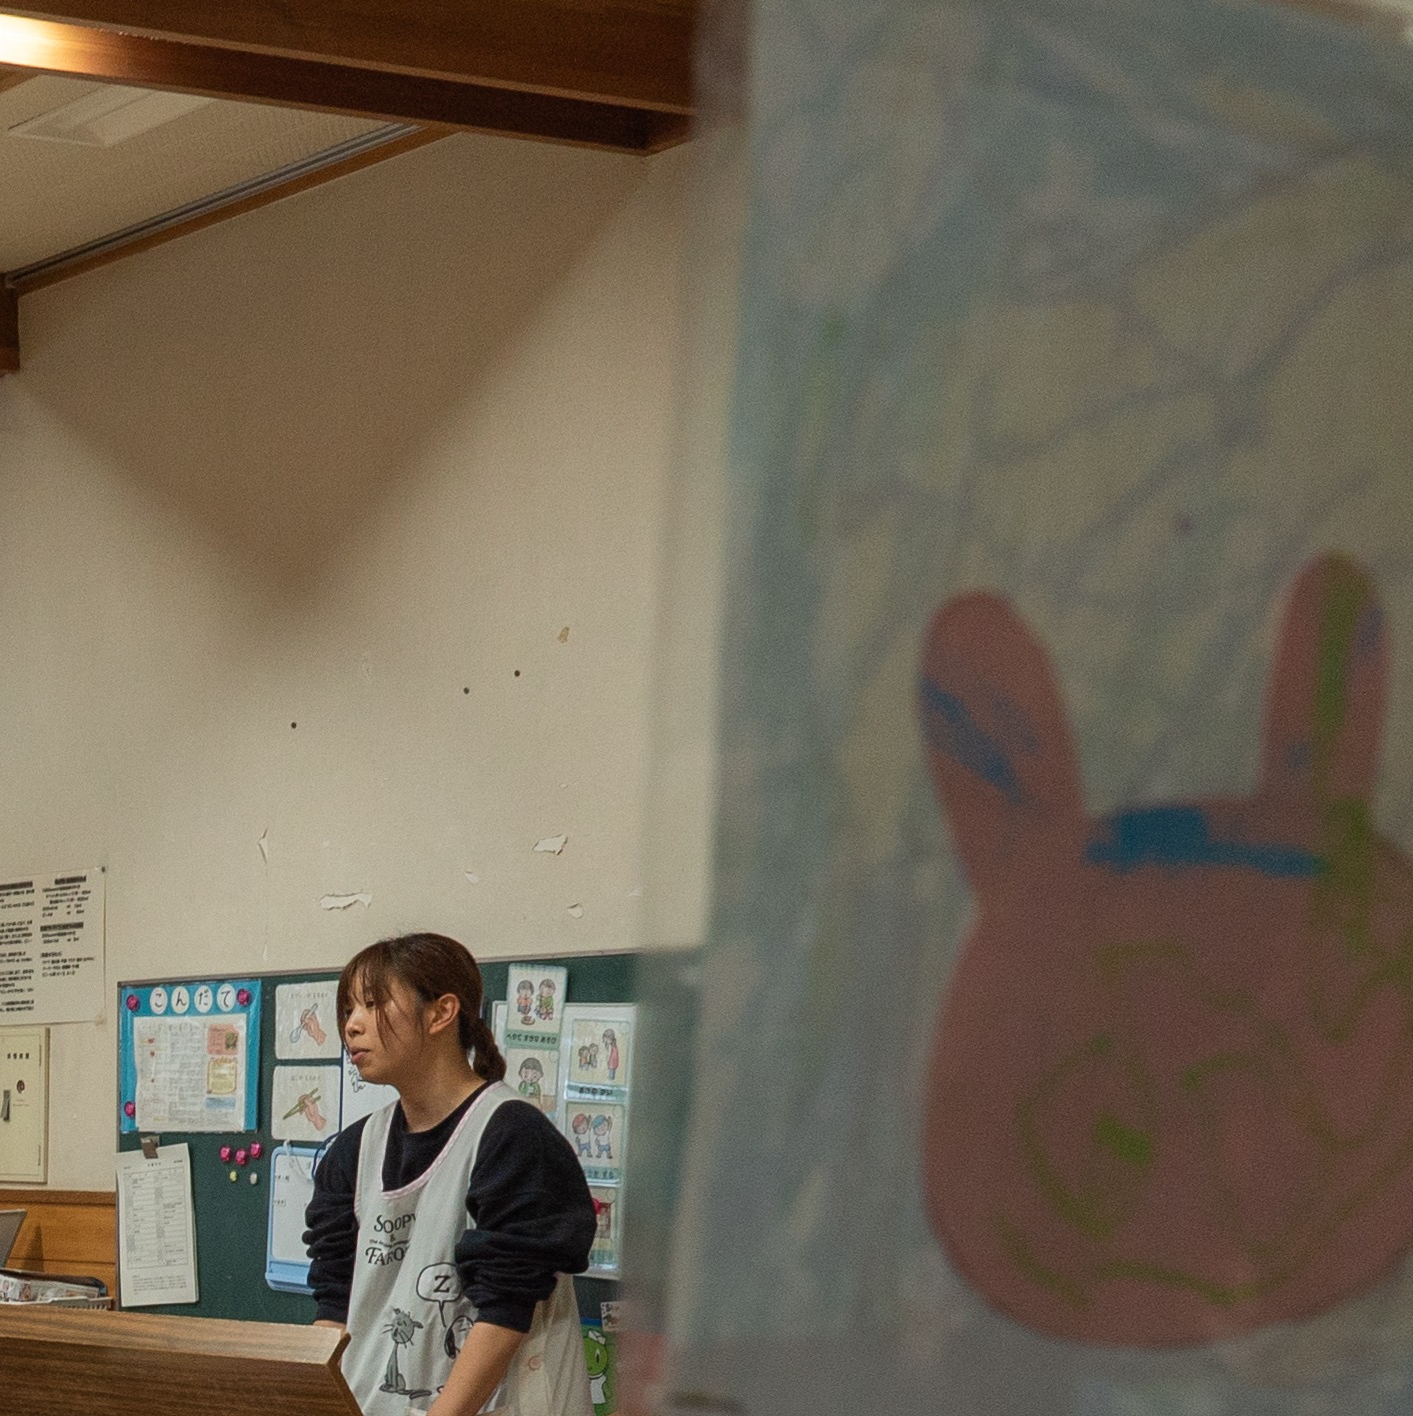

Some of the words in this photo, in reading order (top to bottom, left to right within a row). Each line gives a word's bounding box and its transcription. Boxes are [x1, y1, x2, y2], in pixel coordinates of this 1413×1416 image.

[153, 991, 232, 1009] こんだて
[434, 1275, 451, 1293] Z
